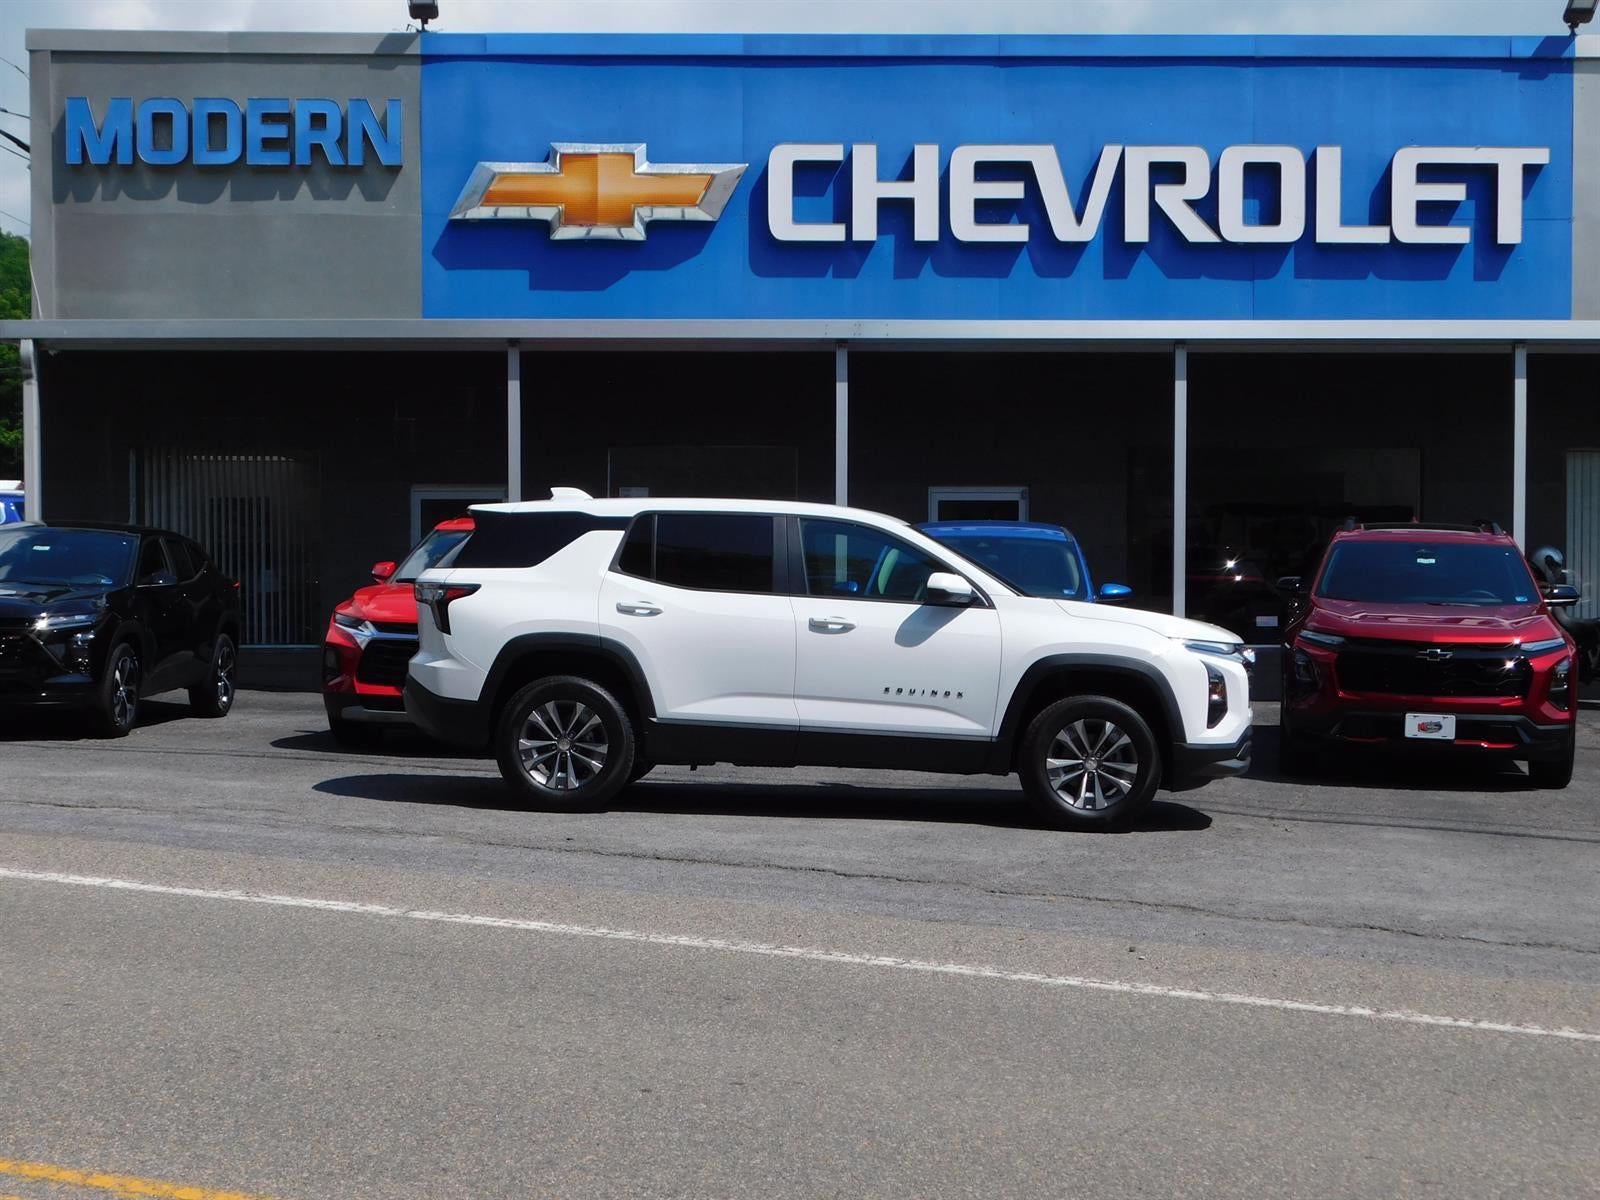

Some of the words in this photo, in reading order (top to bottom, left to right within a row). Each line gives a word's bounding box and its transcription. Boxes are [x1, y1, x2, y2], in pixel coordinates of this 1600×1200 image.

[65, 97, 402, 167] MODERN
[767, 143, 1550, 245] CHEVROLET
[883, 686, 964, 699] EQUINOX
